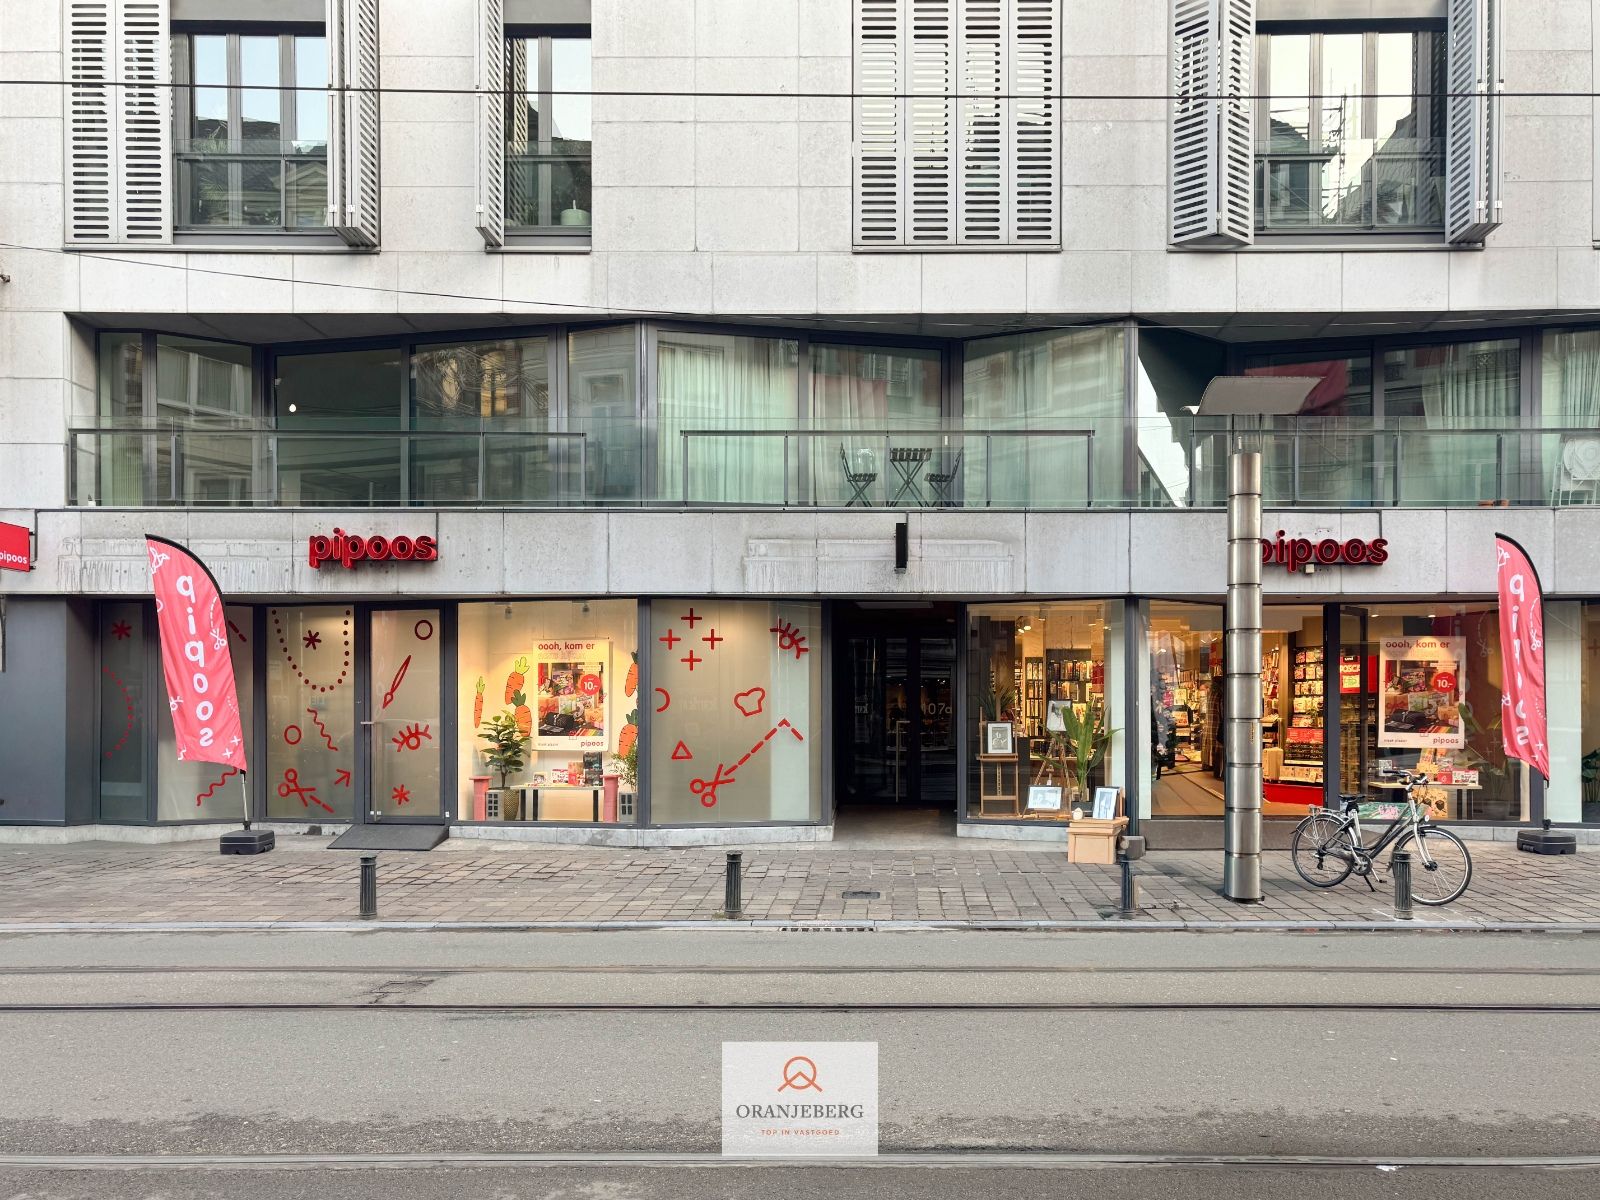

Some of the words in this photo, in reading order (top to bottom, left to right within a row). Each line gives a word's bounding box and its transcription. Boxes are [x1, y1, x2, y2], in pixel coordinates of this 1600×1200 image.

[308, 527, 437, 569] pipoos
[538, 642, 562, 651] oooh,
[564, 642, 583, 650] kom
[1385, 639, 1412, 649] oooh,
[1415, 640, 1437, 648] kom
